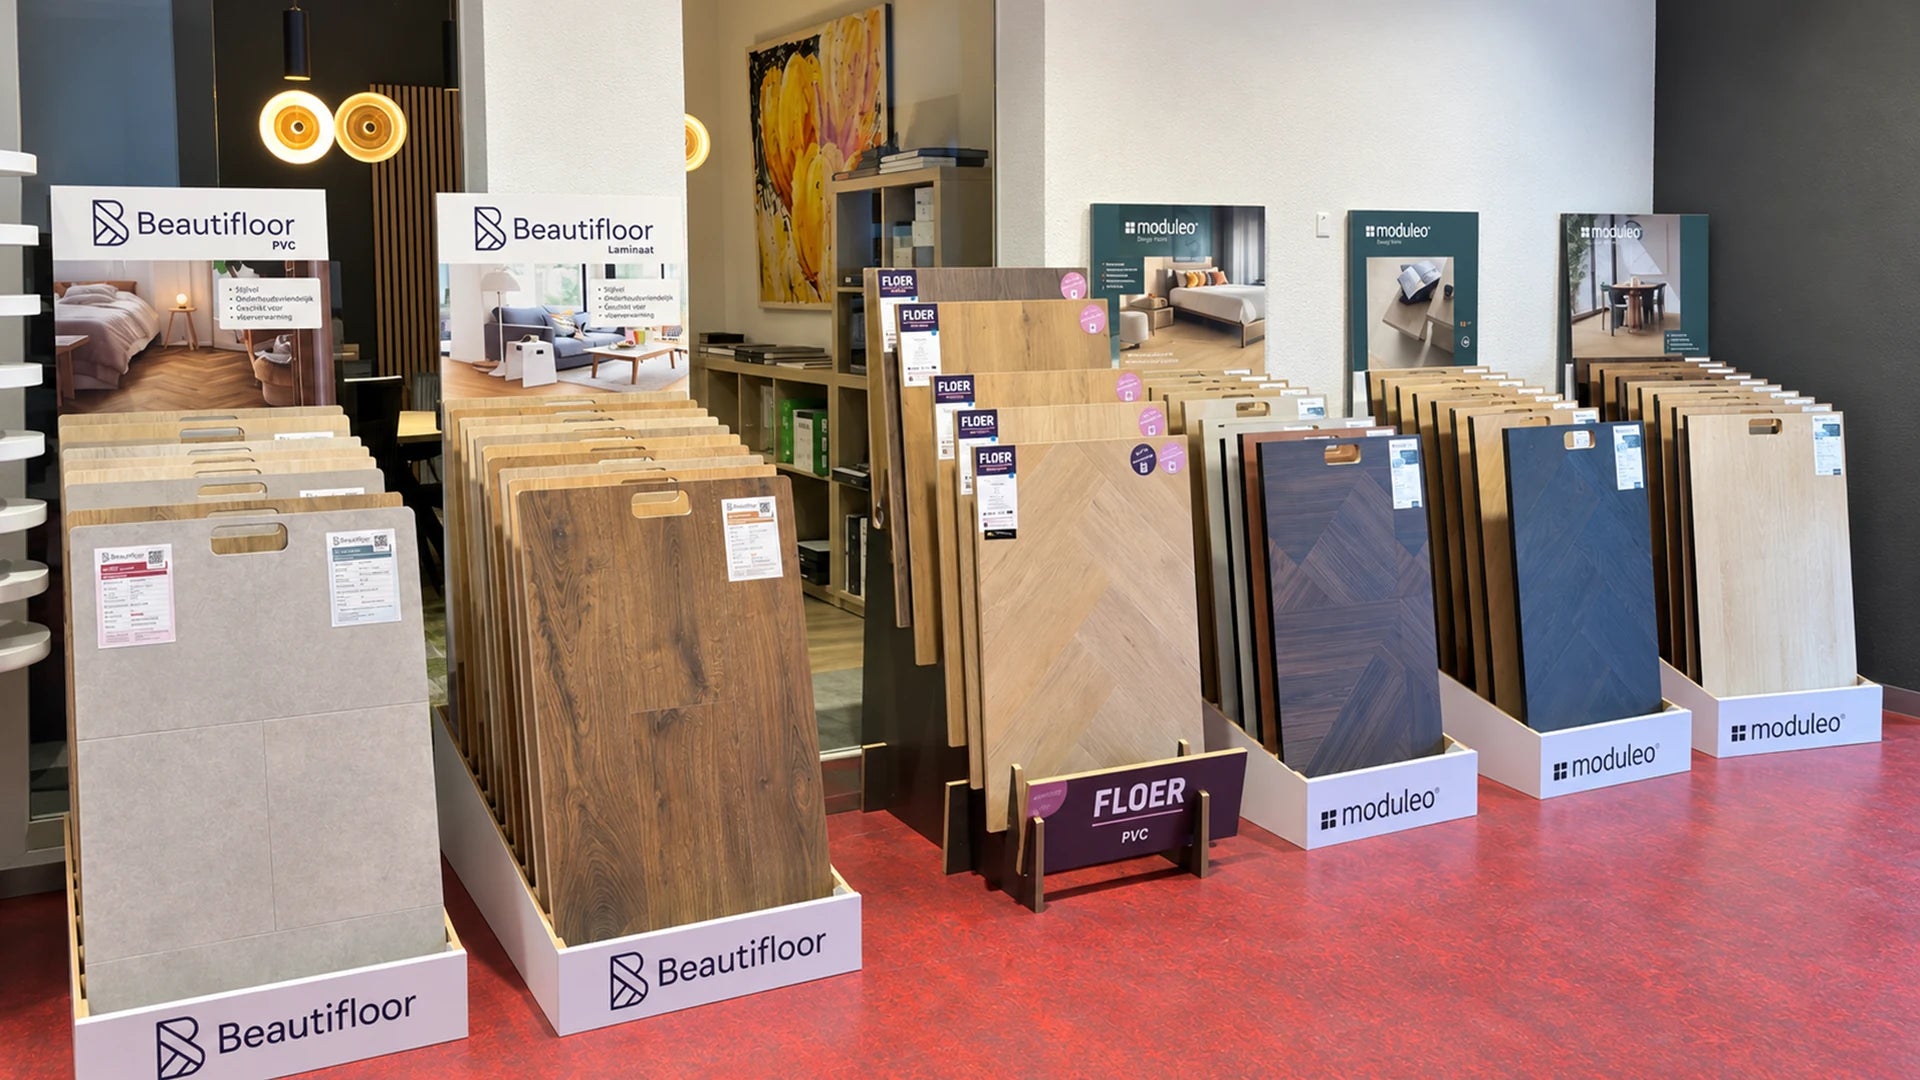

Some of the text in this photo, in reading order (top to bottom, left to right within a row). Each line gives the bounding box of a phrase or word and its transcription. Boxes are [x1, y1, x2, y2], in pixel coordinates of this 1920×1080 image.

[137, 211, 295, 236] Beautifloor
[513, 217, 654, 241] Beautifloor
[1137, 218, 1195, 235] moduleo
[1376, 222, 1429, 238] moduleo
[1591, 224, 1641, 239] moduleo
[272, 240, 296, 251] PVC
[608, 244, 654, 255] Laminaat
[881, 275, 914, 288] FLOER
[902, 309, 935, 321] FLOER
[938, 380, 971, 393] FLOER
[961, 414, 995, 428] FLOER
[979, 451, 1013, 465] FLOER
[1093, 777, 1186, 818] FLOER
[1121, 827, 1149, 844] PVC
[658, 932, 827, 987] Beautifloor
[218, 994, 417, 1054] Beautifloor
